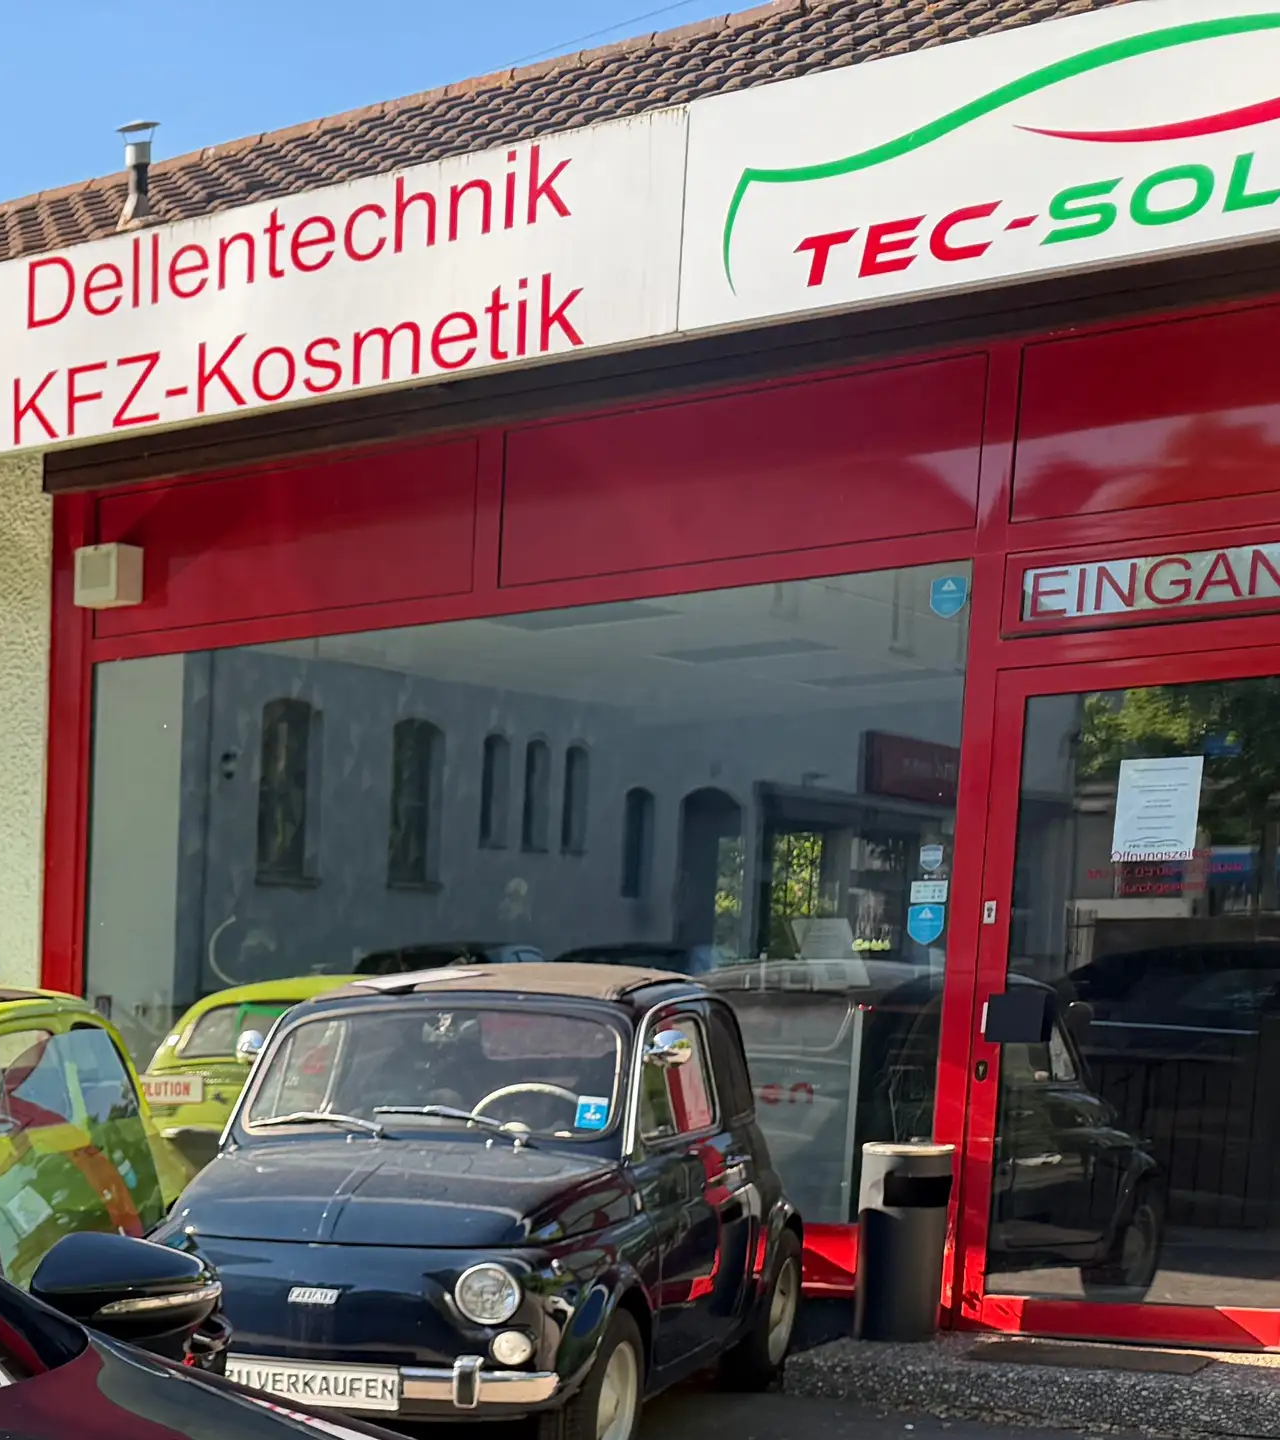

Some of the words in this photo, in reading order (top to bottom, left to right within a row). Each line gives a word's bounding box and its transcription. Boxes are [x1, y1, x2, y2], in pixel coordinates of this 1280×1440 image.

[26, 144, 574, 330] Dellentechnik
[13, 272, 585, 446] KFZ-Kosmetik
[256, 1370, 396, 1400] VERKAUFEN
